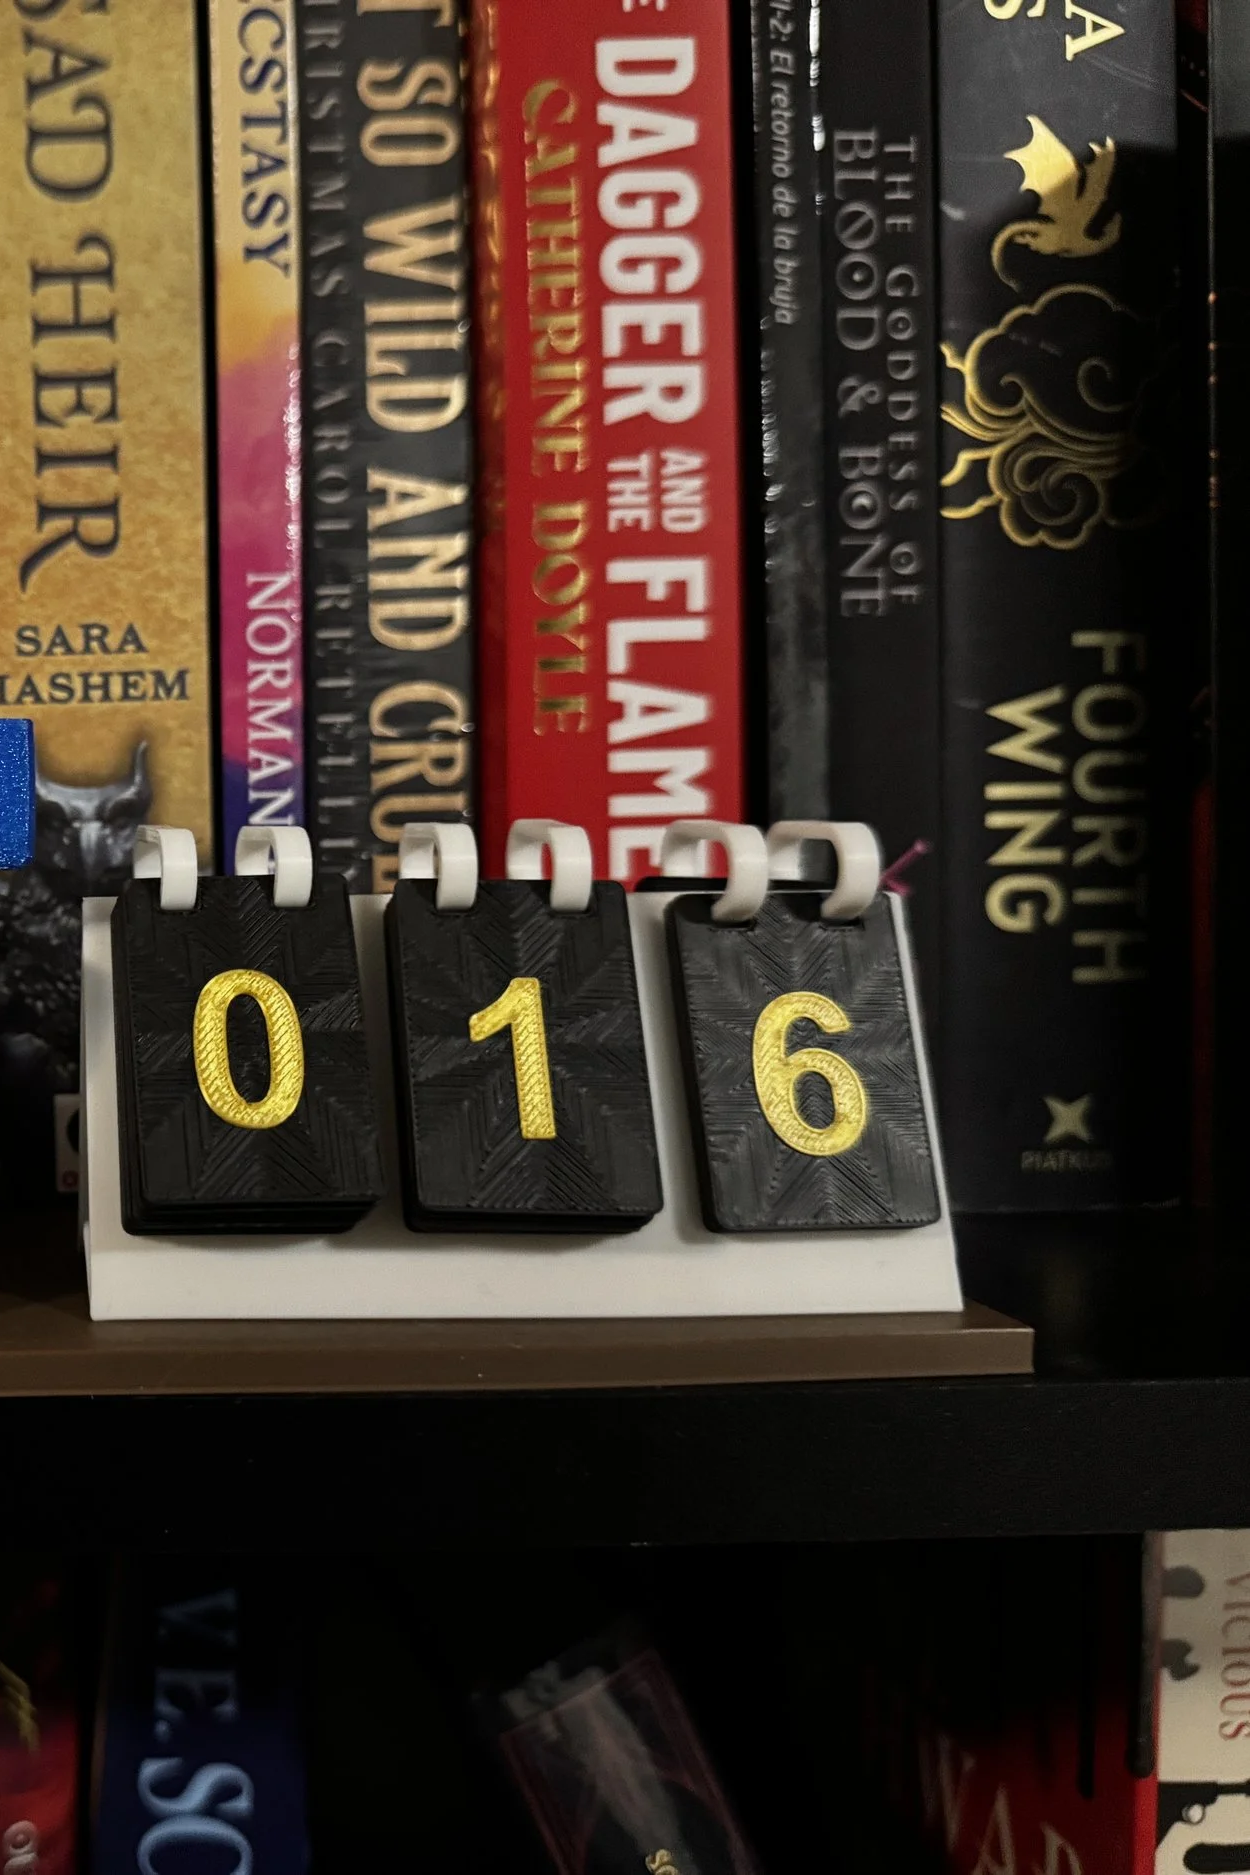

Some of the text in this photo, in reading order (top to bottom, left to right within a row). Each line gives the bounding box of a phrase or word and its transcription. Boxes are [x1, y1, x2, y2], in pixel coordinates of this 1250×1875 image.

[238, 0, 291, 280] CSTASY
[301, 0, 350, 298] RISTMAS
[355, 57, 462, 169] SO
[769, 48, 796, 76] El
[769, 80, 796, 179] retorno
[594, 36, 708, 426] DAGGER
[768, 254, 800, 326] bruja
[771, 182, 798, 219] de
[773, 224, 800, 251] la
[19, 231, 123, 593] HEIR
[361, 194, 469, 433] WILD
[520, 78, 595, 737] CATHERINE DOYLE
[833, 127, 890, 618] BLOOD & BONE
[882, 135, 922, 605] THE GODDESS OF
[311, 329, 353, 549] CAROL
[605, 449, 656, 533] THE
[660, 446, 710, 535] AND
[14, 623, 150, 659] SARA
[366, 463, 472, 651] AND
[983, 682, 1069, 935] WING
[1069, 628, 1149, 985] FOURTH
[191, 967, 868, 1157] 0 1 6
